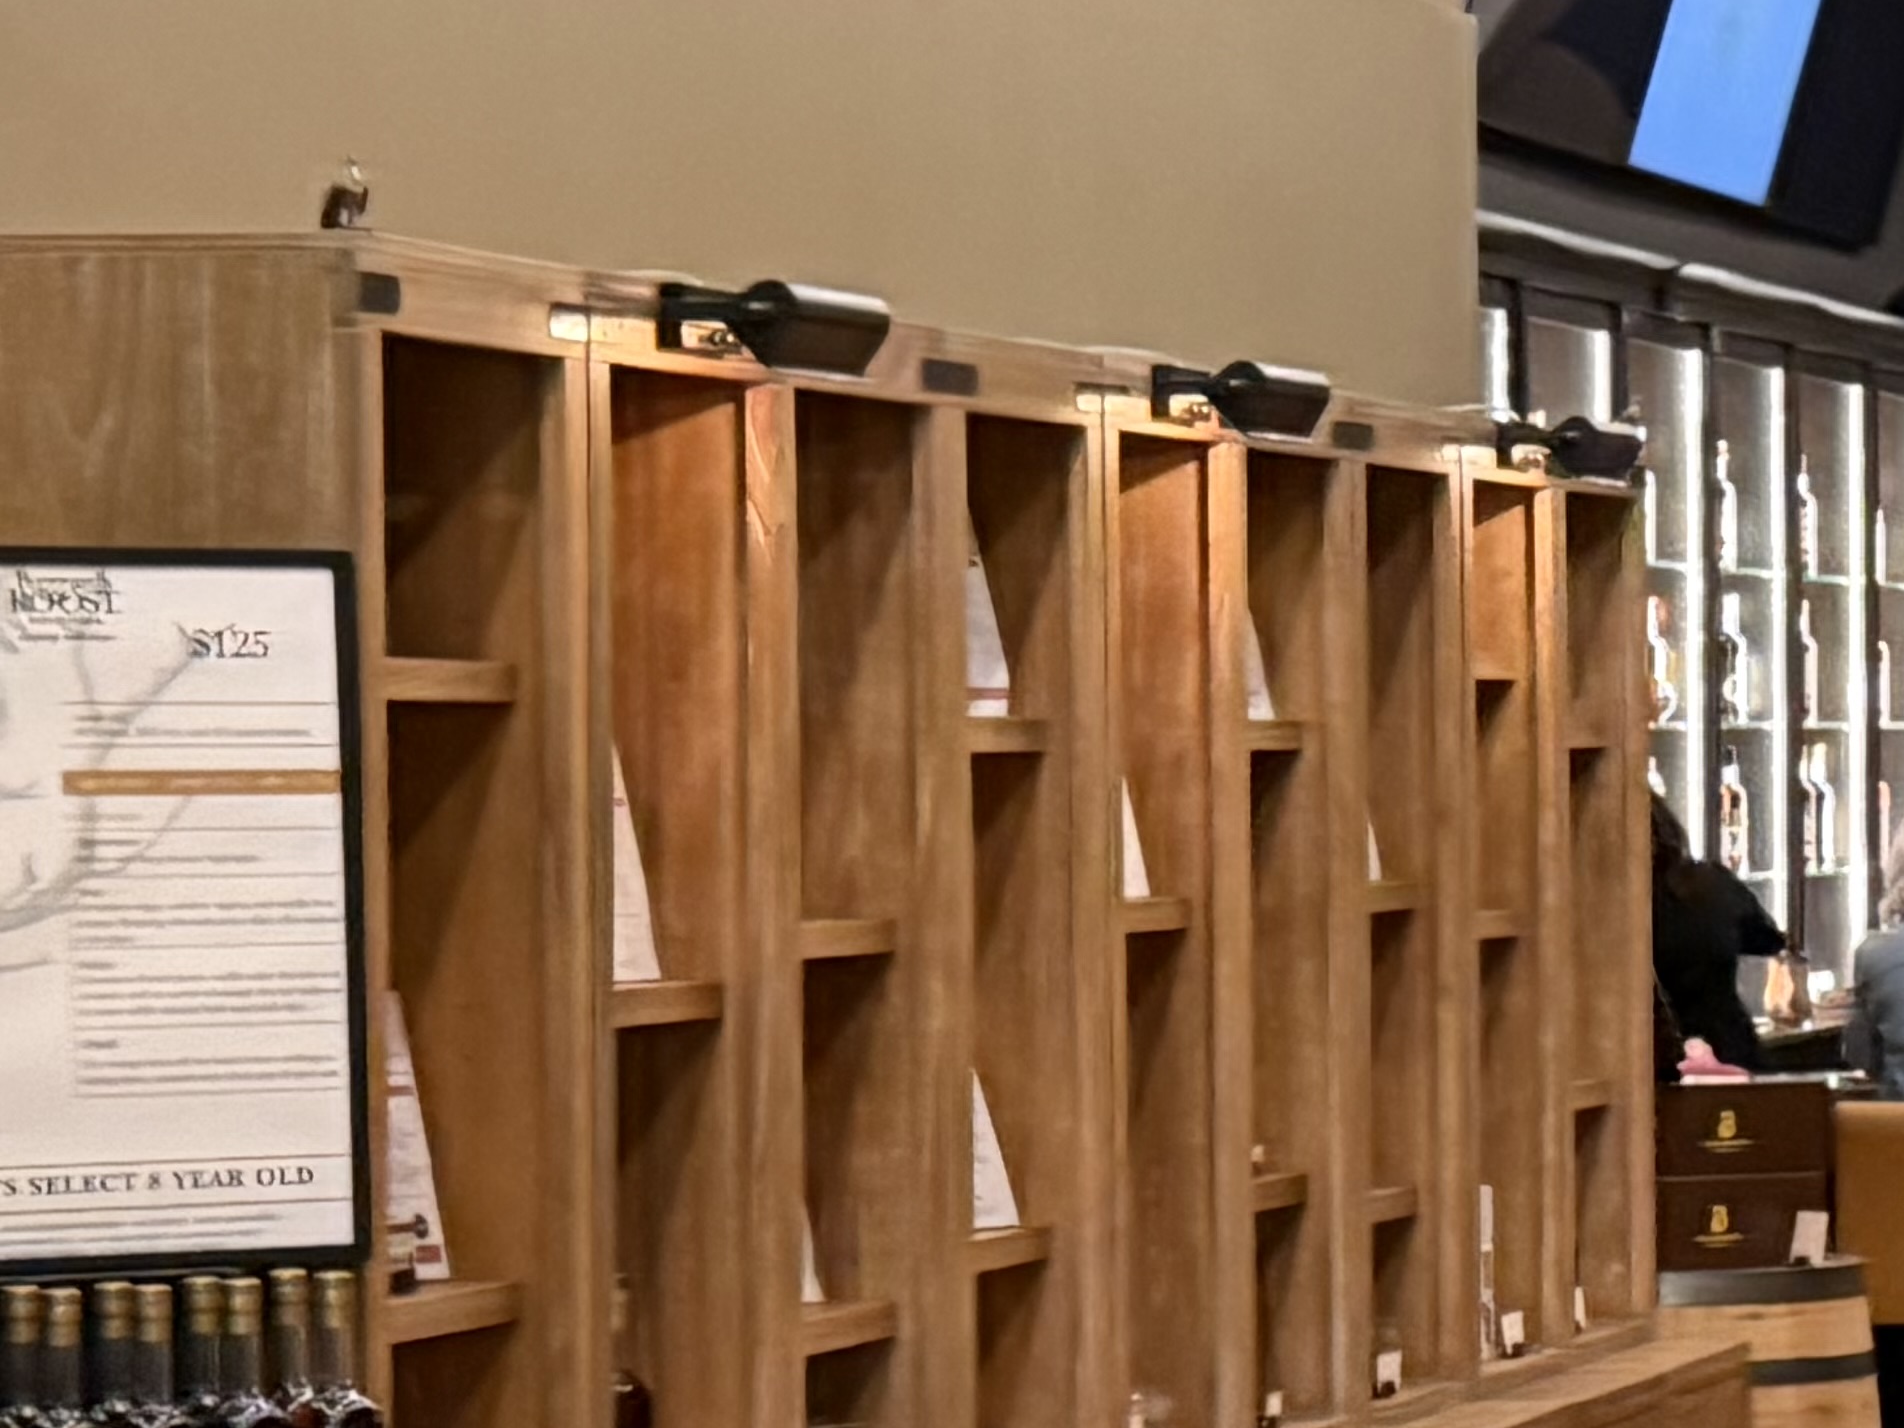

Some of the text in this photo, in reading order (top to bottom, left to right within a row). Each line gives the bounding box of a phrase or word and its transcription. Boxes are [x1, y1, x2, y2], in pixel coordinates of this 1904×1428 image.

[190, 627, 273, 659] $125
[28, 1172, 139, 1196] SELECT
[172, 1169, 244, 1190] YEAR
[256, 1166, 314, 1187] OLD
